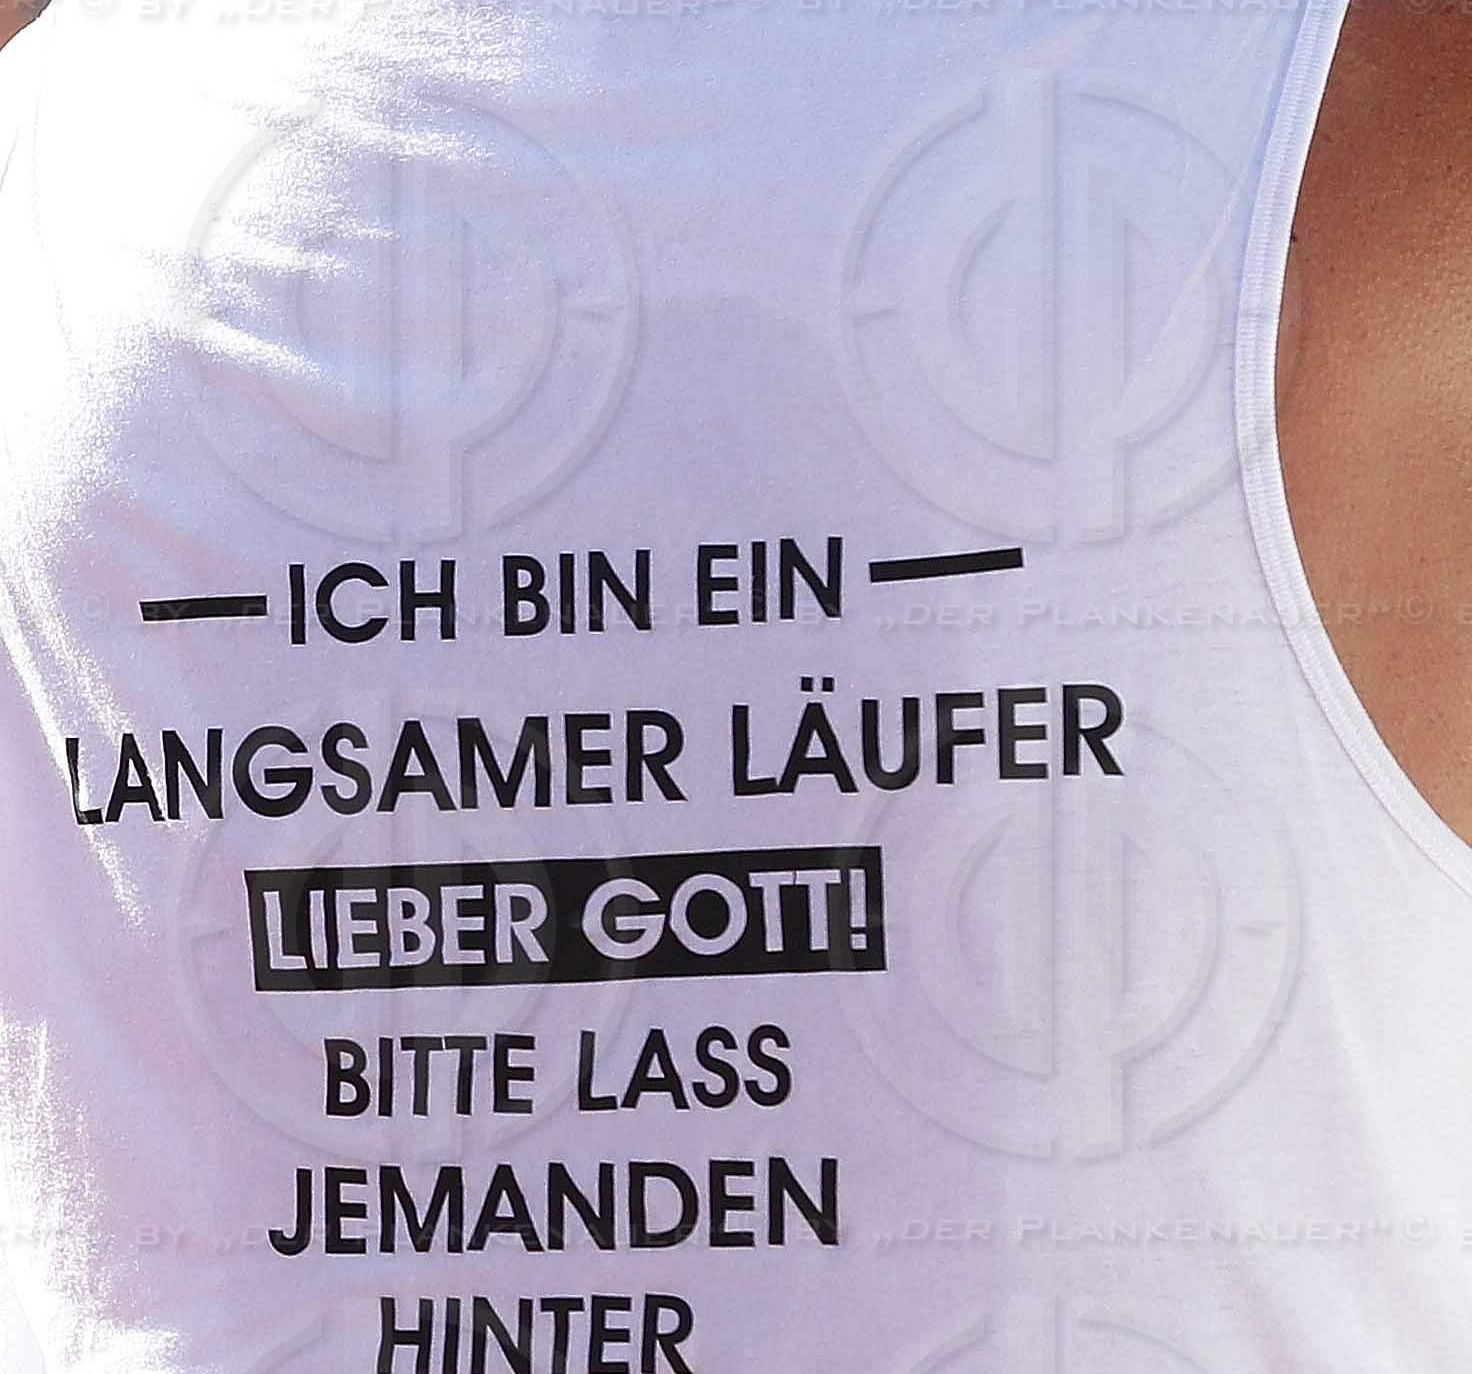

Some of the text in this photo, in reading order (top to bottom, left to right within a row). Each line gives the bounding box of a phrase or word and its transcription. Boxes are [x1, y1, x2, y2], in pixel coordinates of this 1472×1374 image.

[290, 537, 842, 644] ICH BIN EIN
[66, 677, 1123, 824] LANGSAMER LÄUFER
[262, 868, 869, 972] LIEBER GOTT!
[325, 1025, 791, 1117] BITTE LASS
[269, 1157, 838, 1256] JEMANDEN
